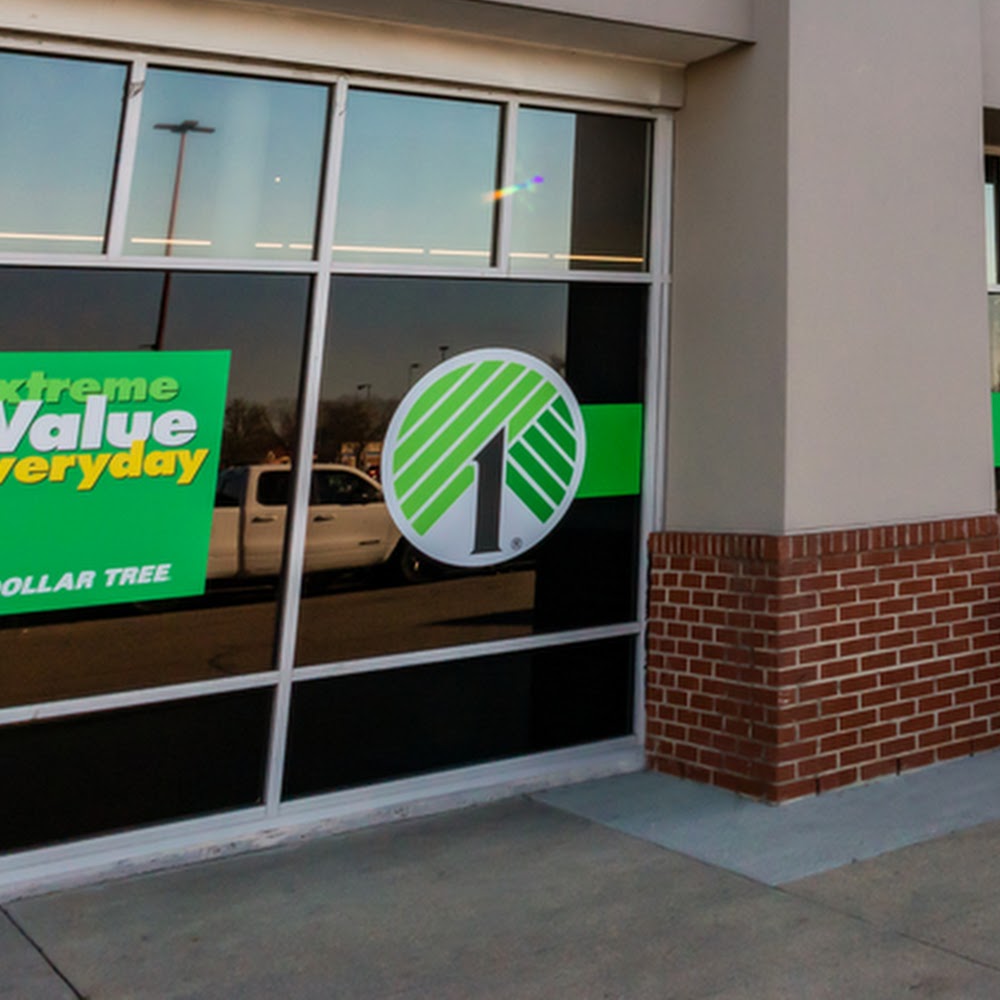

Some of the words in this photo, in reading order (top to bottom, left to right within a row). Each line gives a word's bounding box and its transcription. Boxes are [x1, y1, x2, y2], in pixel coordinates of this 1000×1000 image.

[0, 395, 198, 452] Value
[0, 571, 96, 597] OLLAR
[104, 564, 172, 587] TREE
